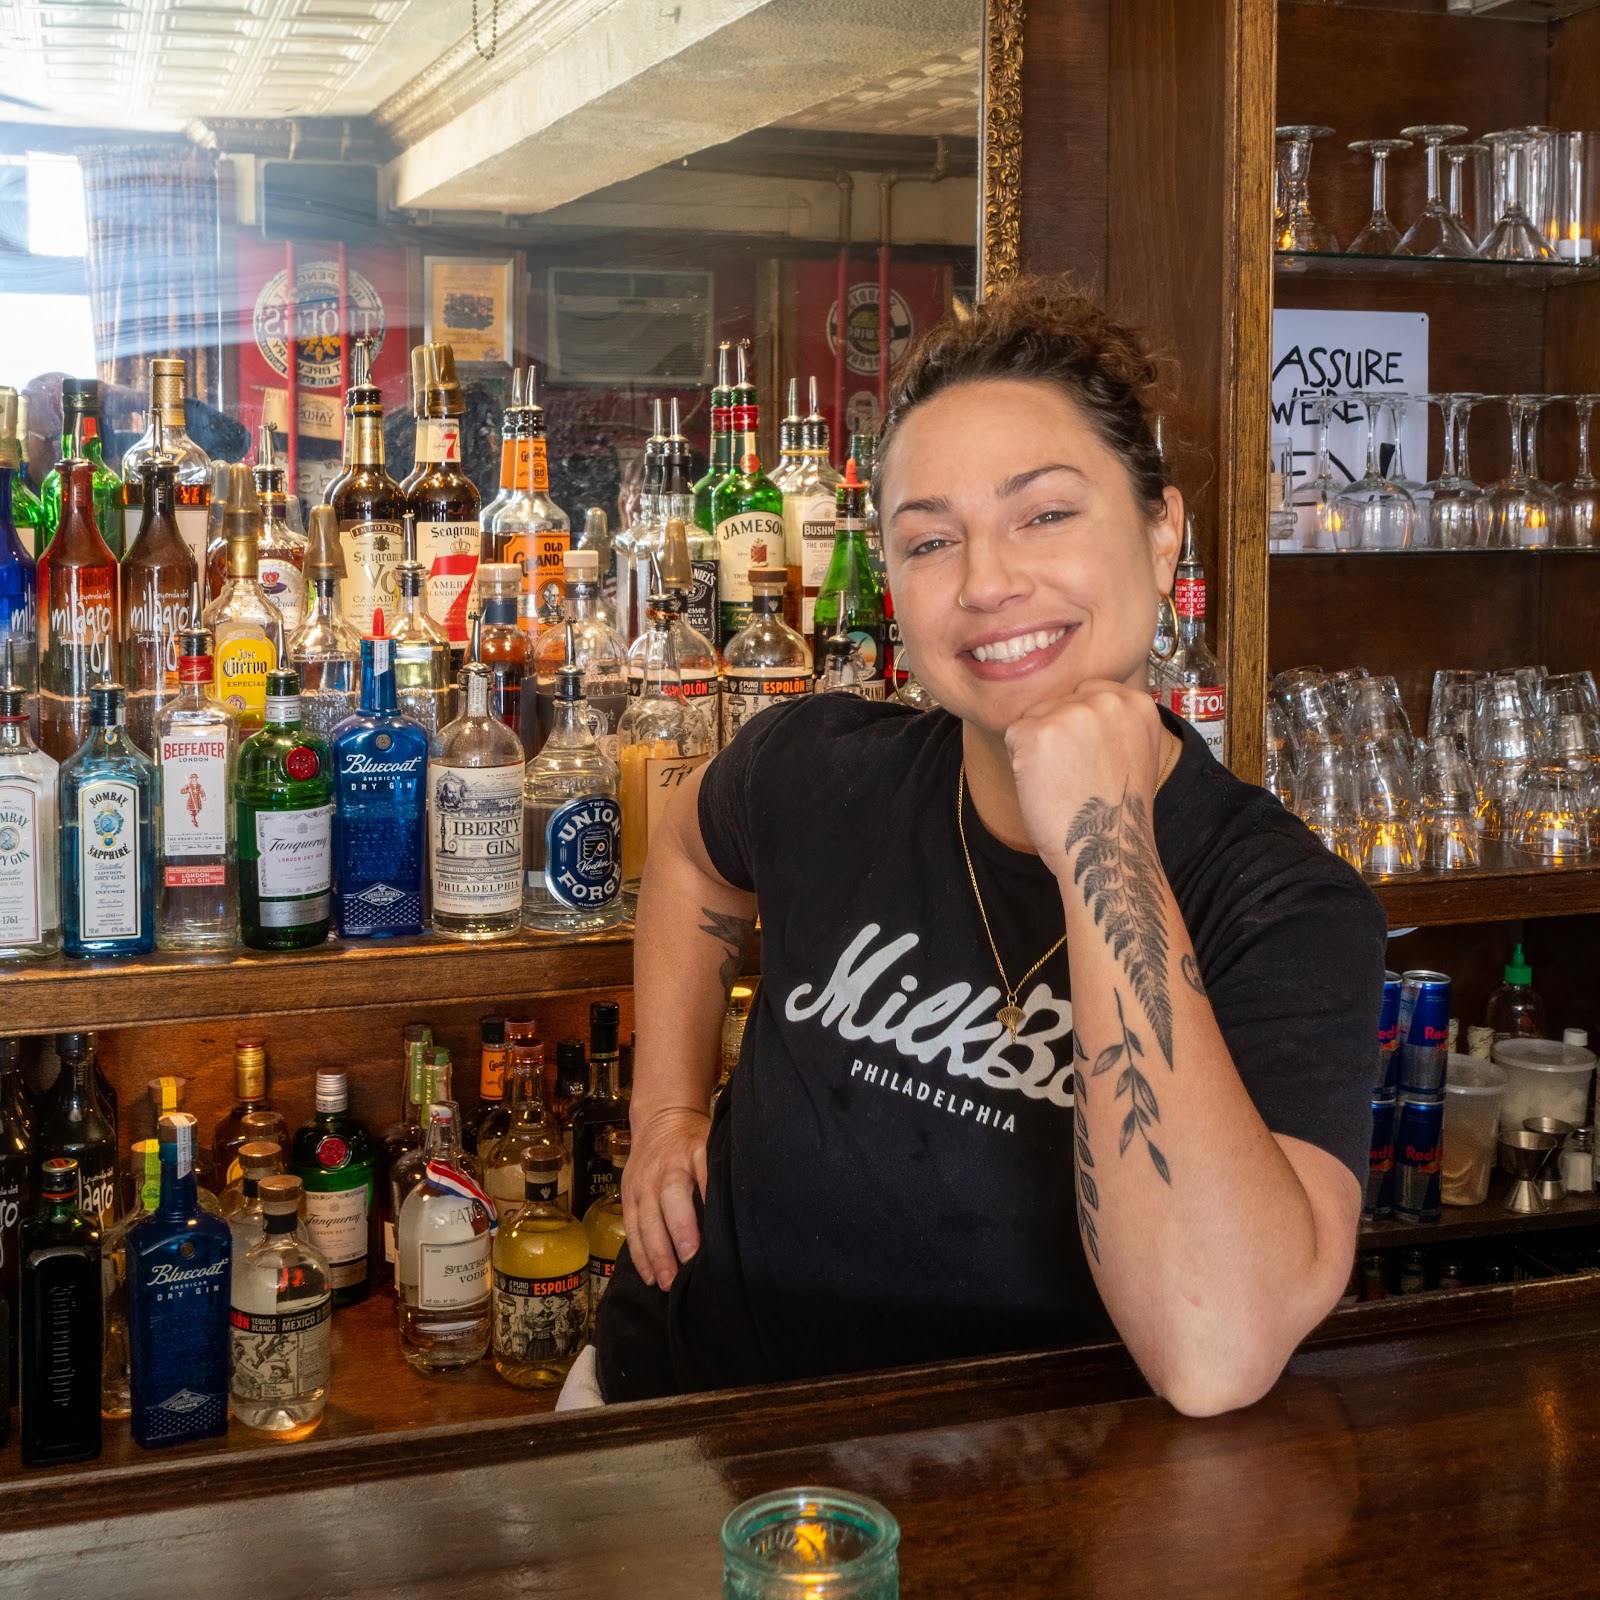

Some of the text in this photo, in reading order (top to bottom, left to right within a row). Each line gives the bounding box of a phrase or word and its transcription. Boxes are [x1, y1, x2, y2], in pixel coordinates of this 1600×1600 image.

[1272, 345, 1404, 388] ASSURE
[443, 433, 458, 459] 7
[723, 519, 784, 540] JAMESON
[544, 542, 563, 552] OLD
[693, 567, 717, 586] NIEL'S
[51, 582, 112, 674] milagro
[130, 581, 189, 672] milagro
[222, 656, 267, 678] Cuervo
[227, 680, 267, 688] ESPECIAL
[1206, 736, 1223, 746] DKA
[163, 741, 225, 761] BEEFEATER
[340, 753, 422, 774] Bluecoat
[88, 791, 129, 809] BOMBAY
[558, 807, 621, 841] UNION
[87, 844, 132, 860] SAPPHIRE
[269, 837, 328, 853] Tanqueray
[486, 839, 515, 855] GIN
[438, 880, 520, 894] PHILADELPHIA
[557, 862, 622, 900] FORGE
[2, 915, 18, 924] 1761
[850, 1058, 1016, 1133] PHILADELPHIA
[146, 1258, 229, 1286] Bluecoat
[157, 1285, 219, 1301] DRY GIN
[251, 1317, 277, 1325] TEQUILA
